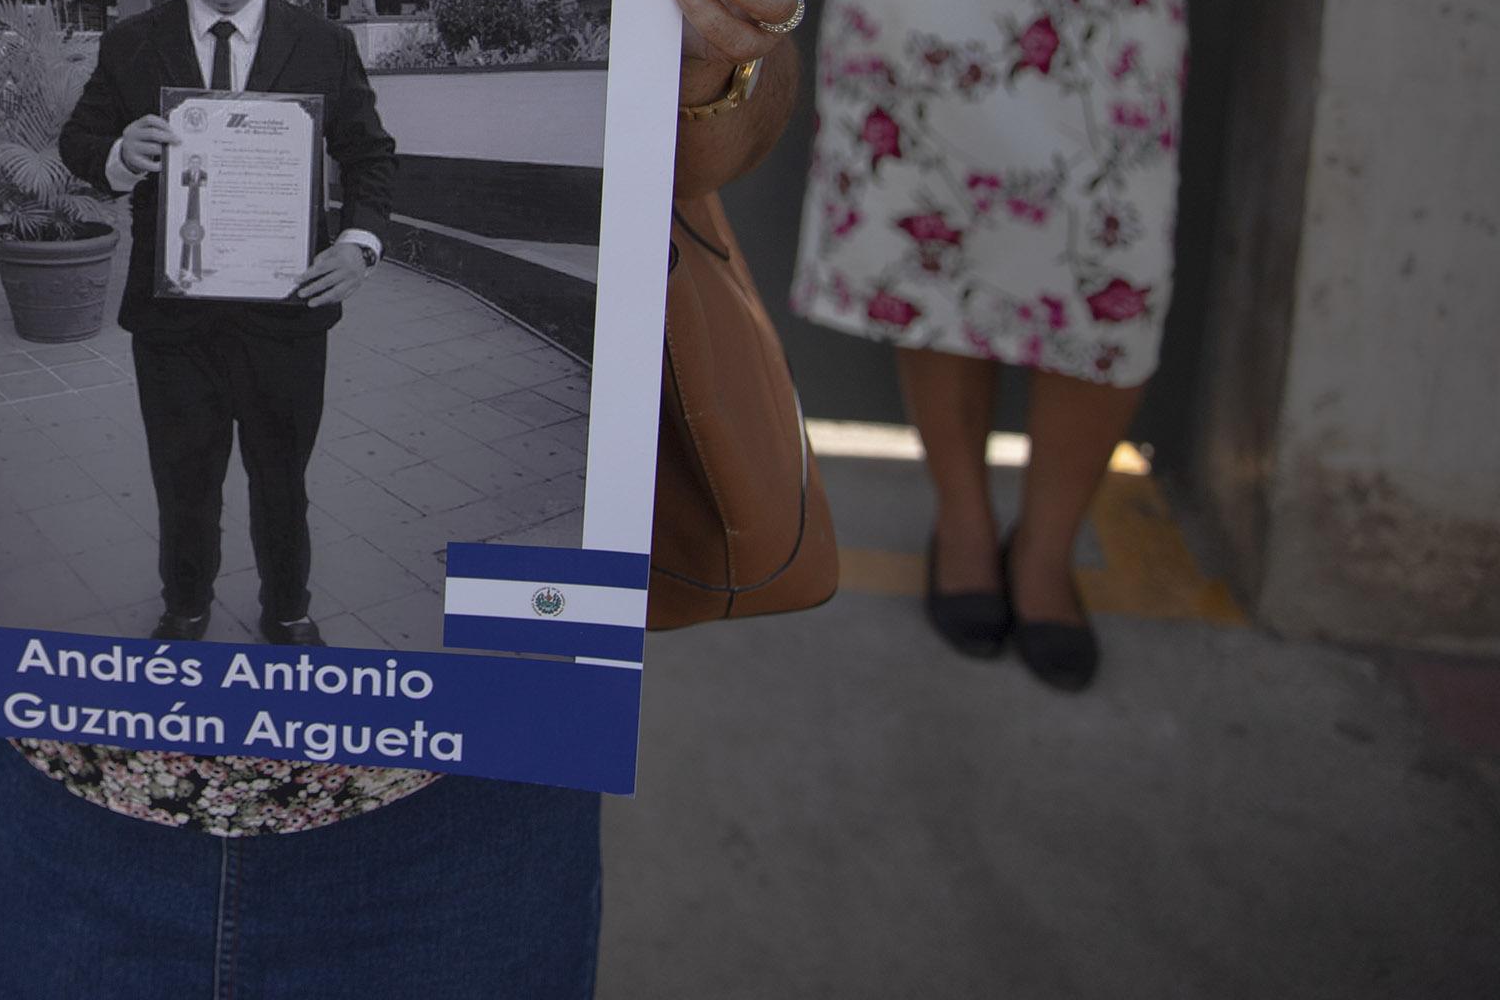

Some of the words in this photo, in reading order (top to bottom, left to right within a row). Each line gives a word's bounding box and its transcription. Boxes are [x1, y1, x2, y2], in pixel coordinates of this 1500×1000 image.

[16, 637, 204, 688] Andrés
[220, 652, 435, 700] Antonio
[2, 690, 225, 746] Guzmán
[242, 710, 464, 763] Argueta
